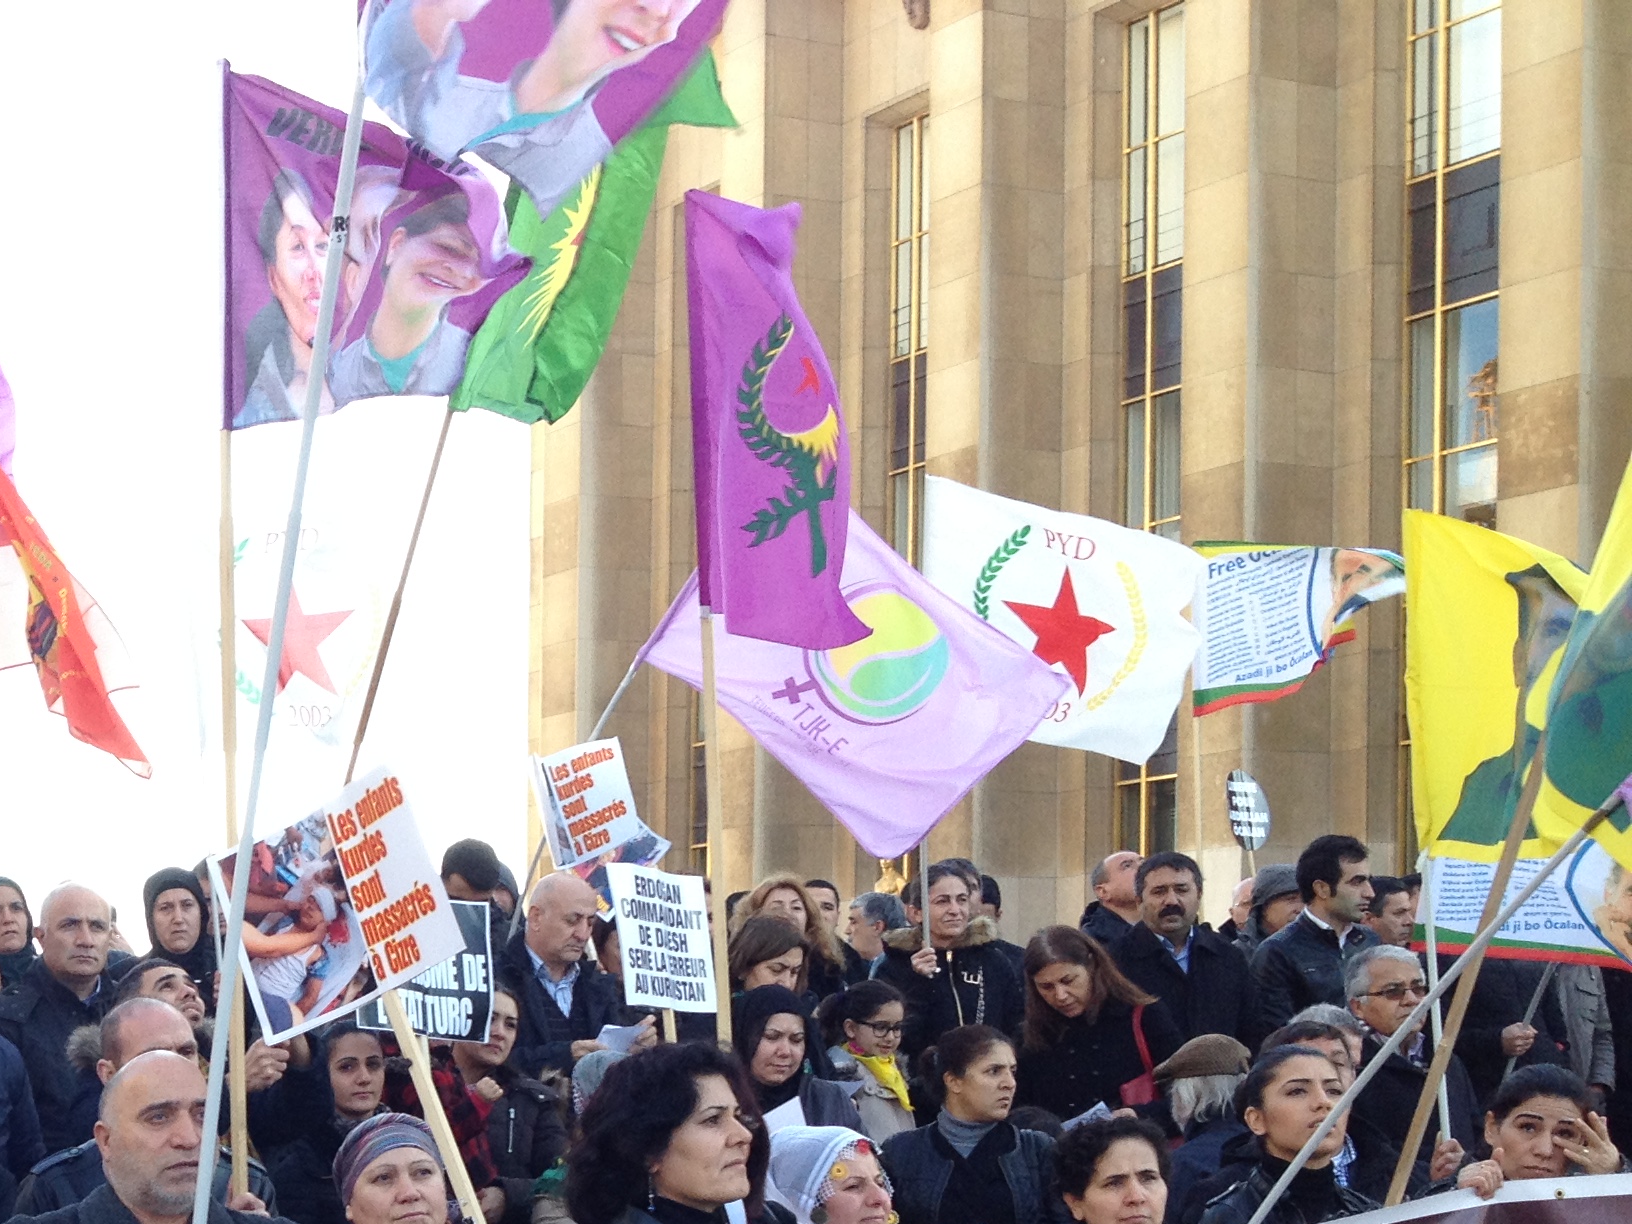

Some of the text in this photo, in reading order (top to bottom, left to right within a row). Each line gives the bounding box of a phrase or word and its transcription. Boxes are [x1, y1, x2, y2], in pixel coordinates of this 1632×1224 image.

[265, 528, 319, 553] PD
[1043, 527, 1096, 560] PYD
[1208, 556, 1246, 580] Free
[328, 776, 404, 845] Les enfants
[350, 869, 387, 914] sont
[360, 880, 438, 948] massacrés
[1524, 920, 1540, 932] bo
[1543, 916, 1586, 932] Öcalan
[638, 924, 653, 947] DE
[369, 947, 387, 981] à
[384, 933, 422, 975] Cizre
[462, 953, 488, 992] DE
[654, 951, 668, 973] LA
[635, 973, 649, 995] AU
[424, 994, 474, 1037] TURC
